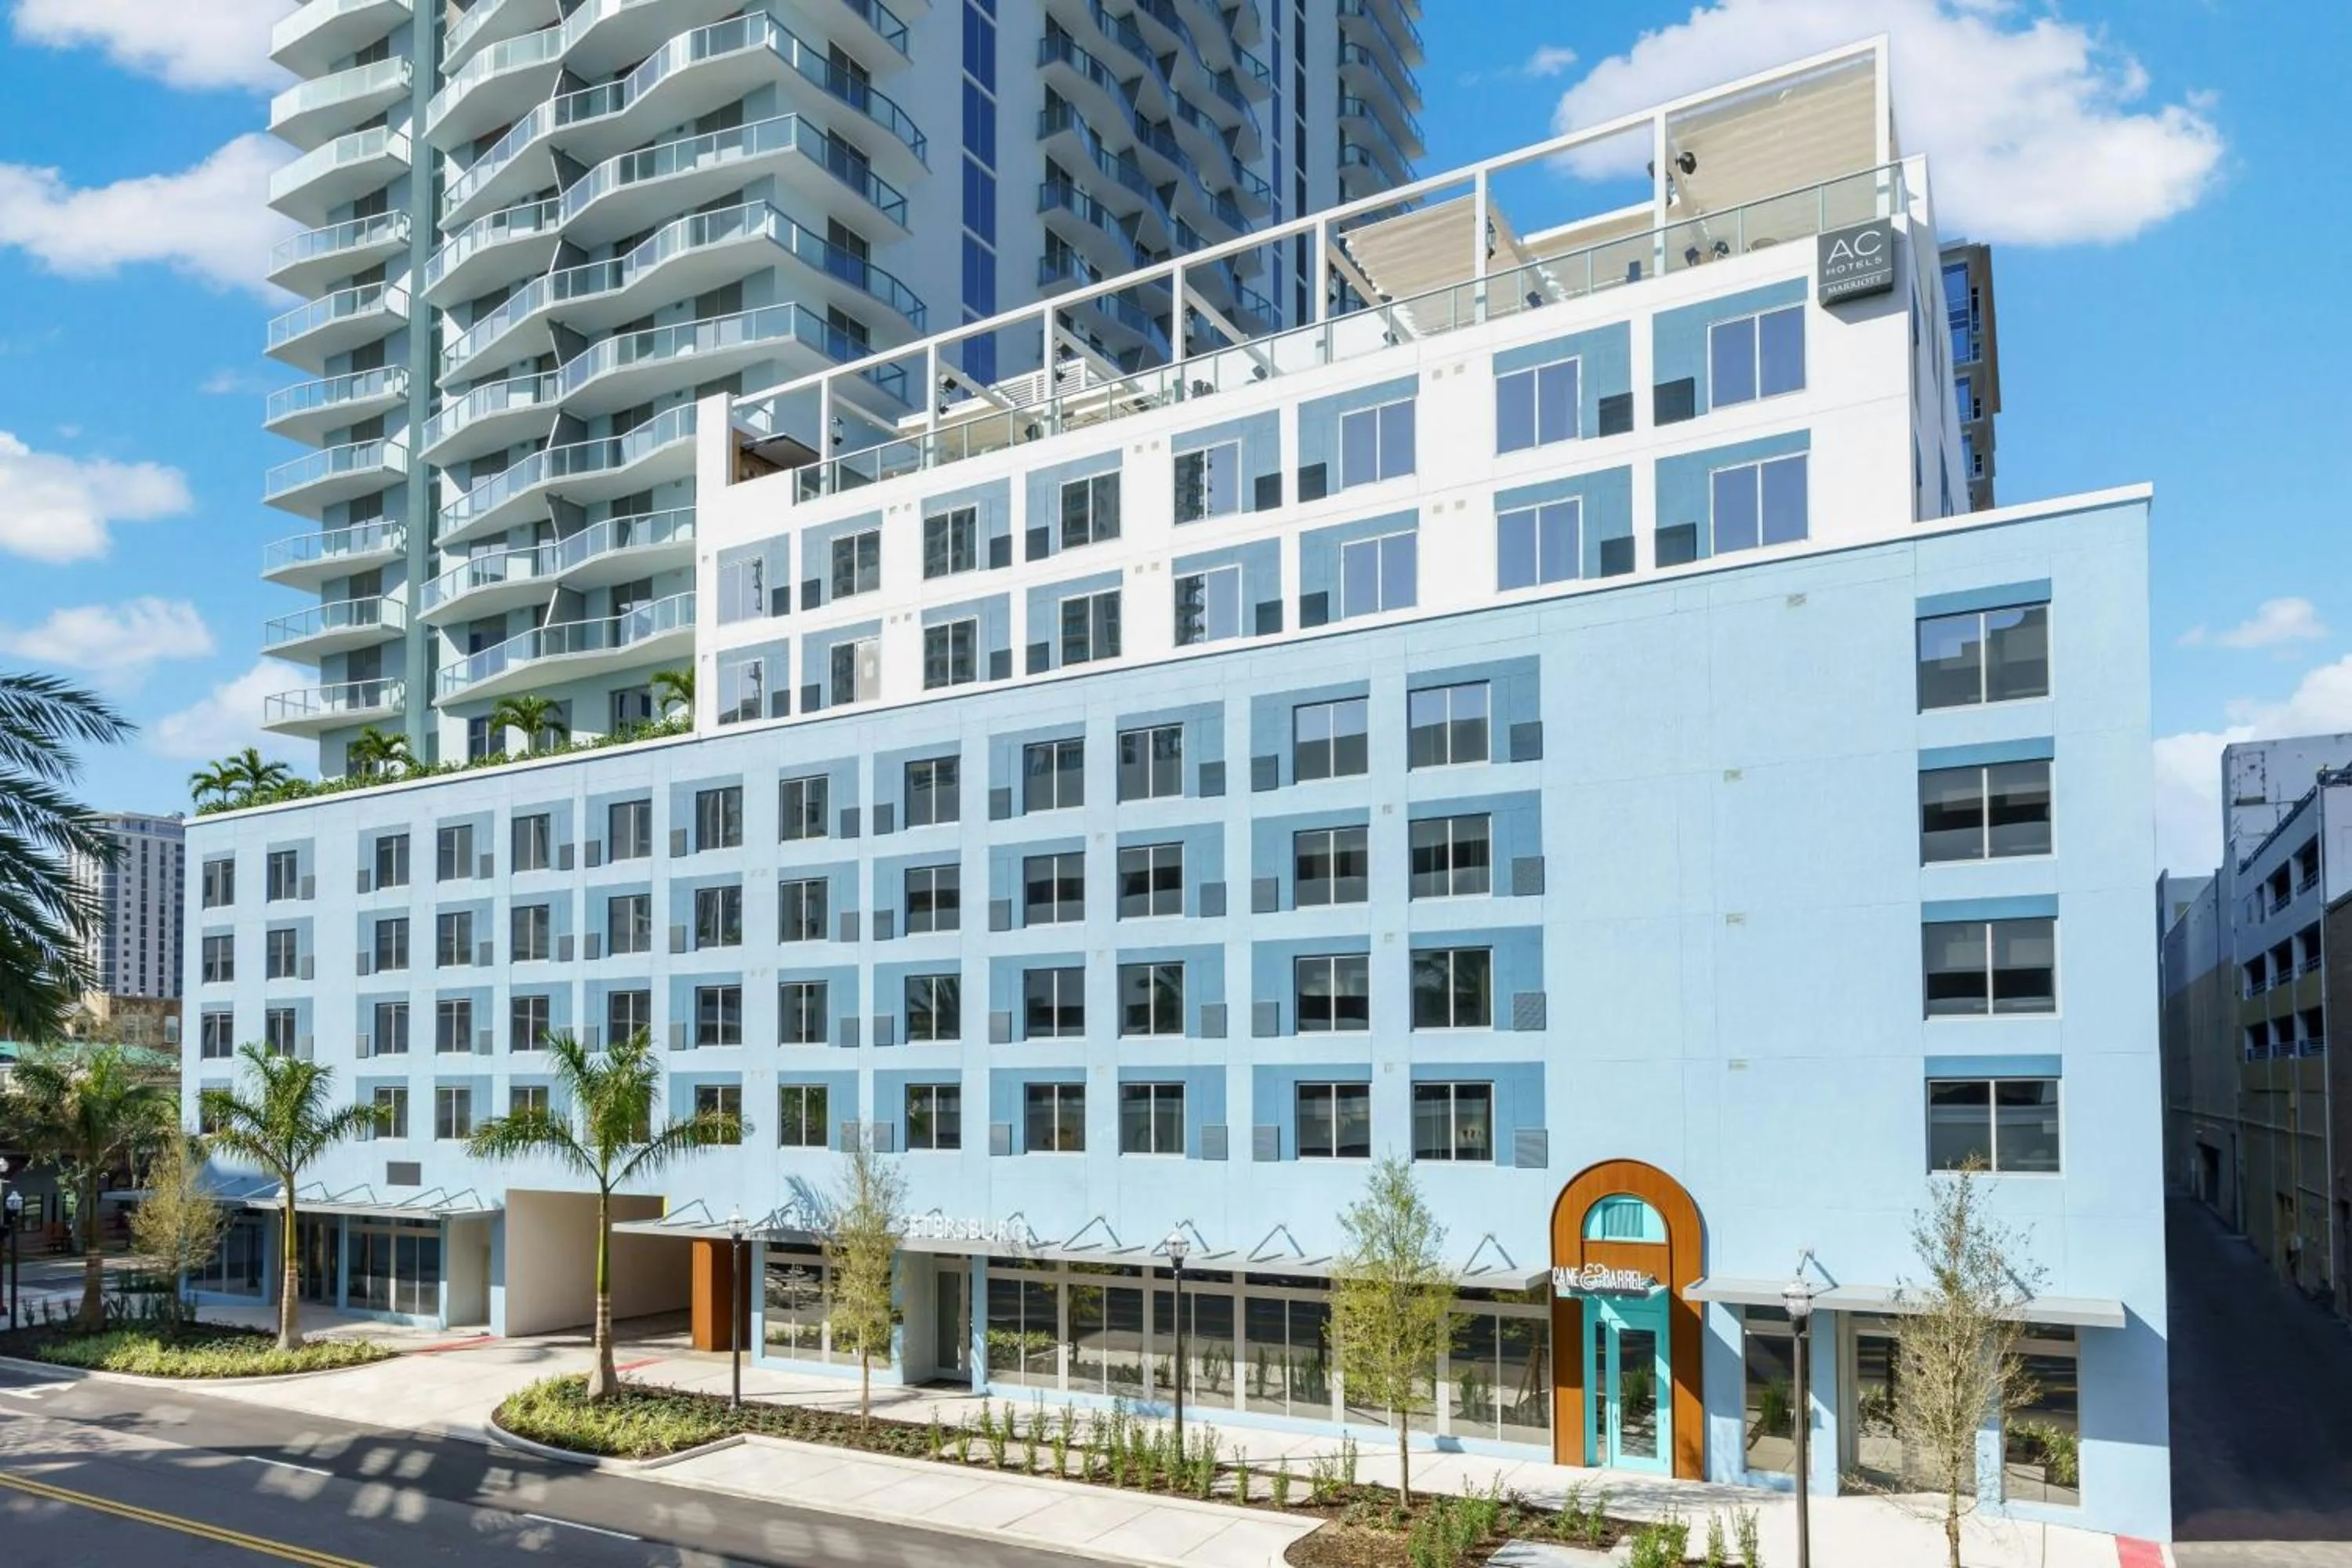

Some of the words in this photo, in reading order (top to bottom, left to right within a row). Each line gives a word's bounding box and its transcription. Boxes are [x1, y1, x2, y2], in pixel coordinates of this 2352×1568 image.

[1827, 230, 1882, 264] AC
[1825, 256, 1882, 276] HOTELS
[1552, 1266, 1579, 1287] CANE
[1580, 1263, 1606, 1290] &
[1604, 1269, 1645, 1290] BARREL
